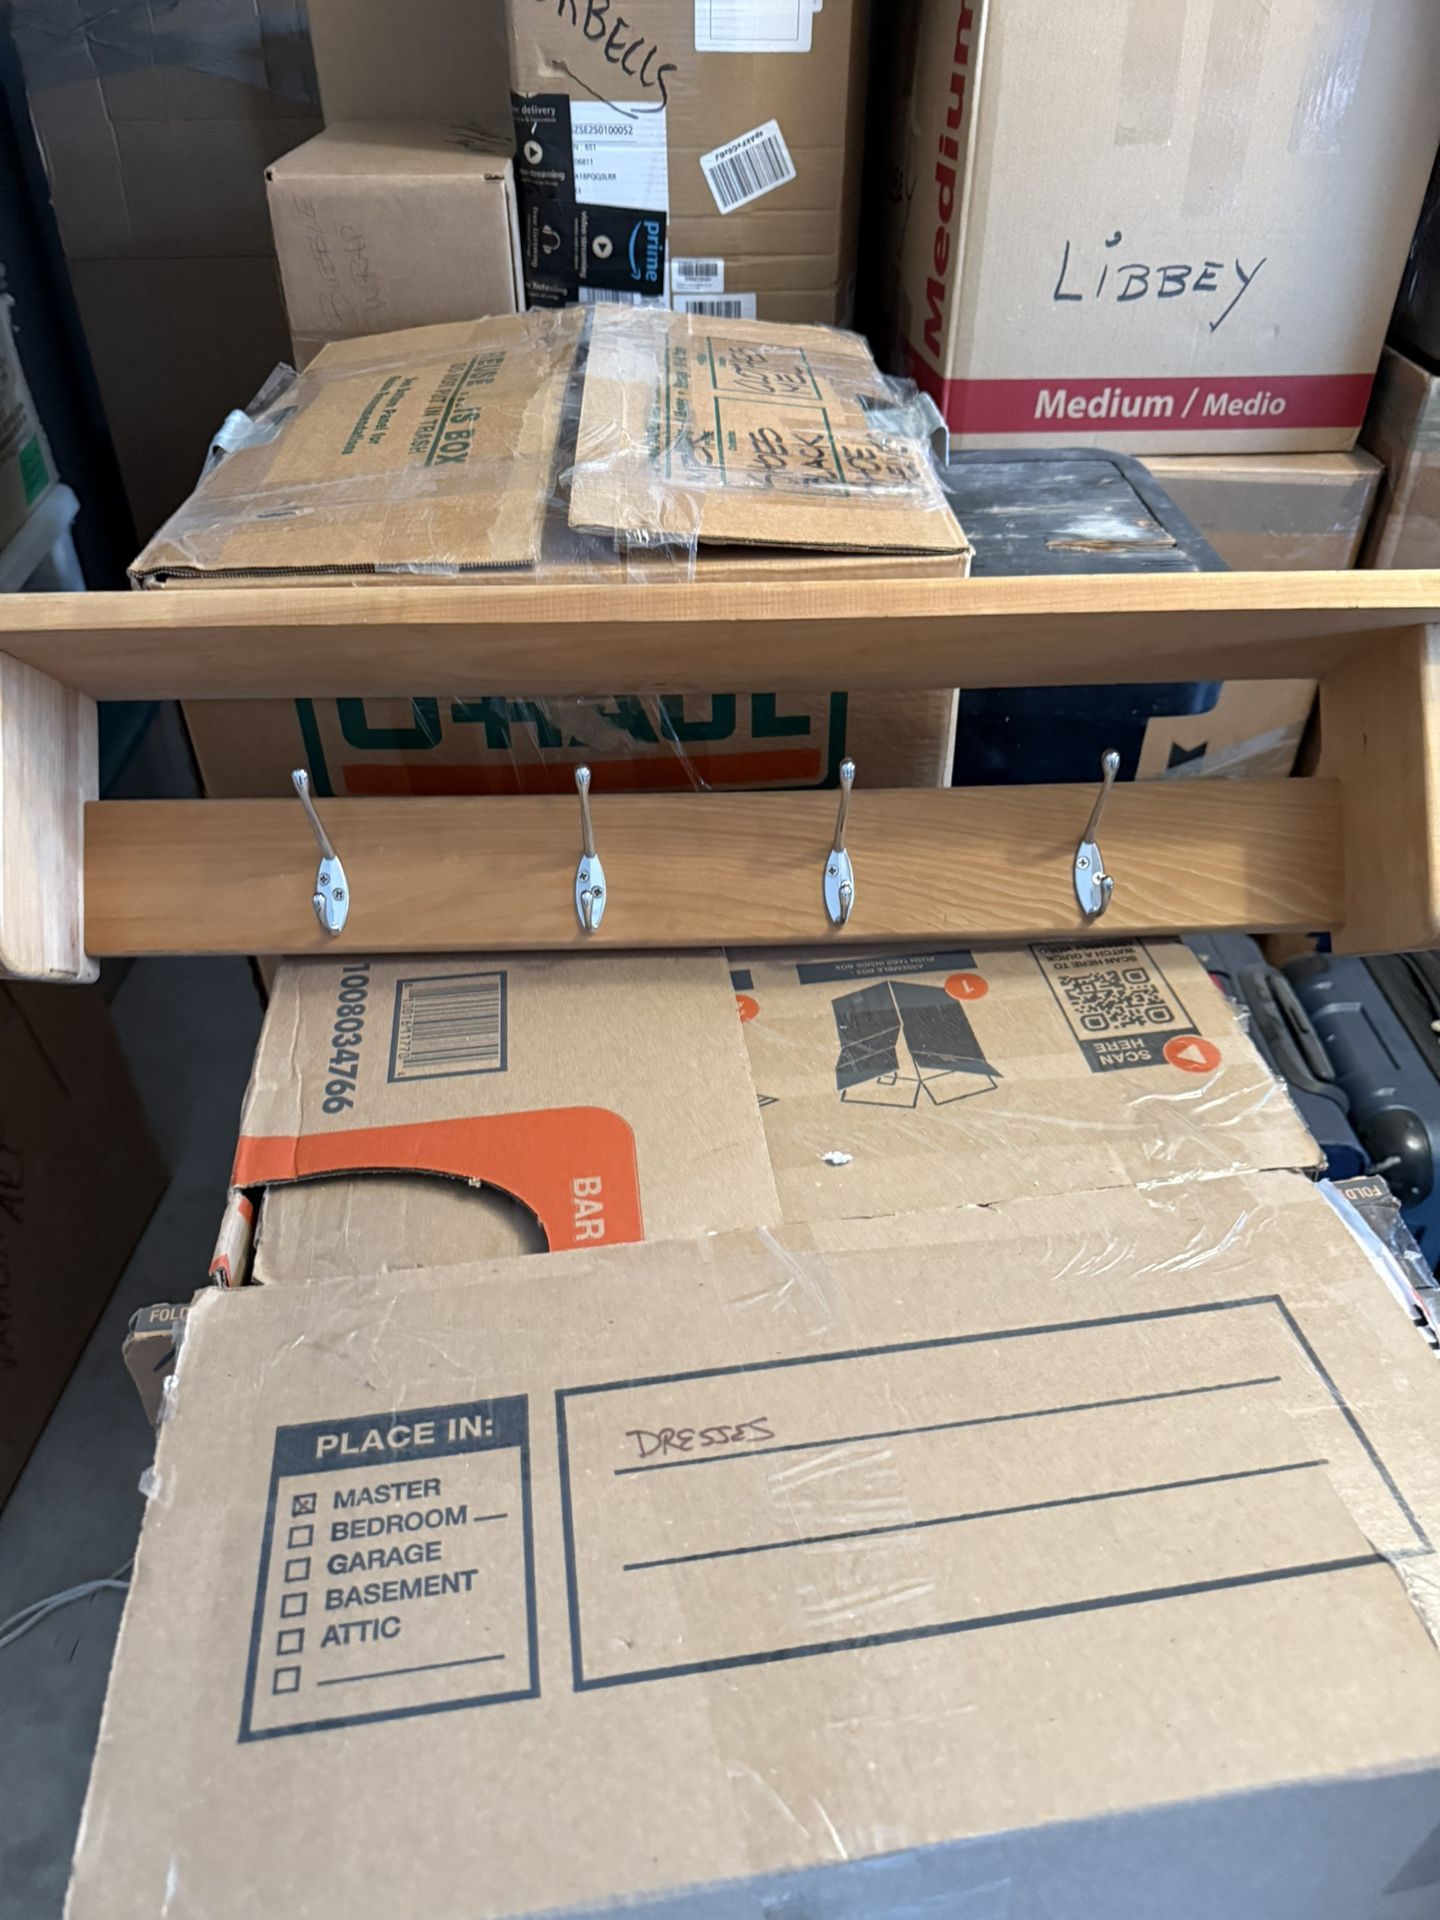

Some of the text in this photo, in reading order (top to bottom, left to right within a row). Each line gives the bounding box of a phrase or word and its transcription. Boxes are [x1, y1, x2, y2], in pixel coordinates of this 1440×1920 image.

[521, 105, 556, 117] delivery
[644, 220, 663, 282] prime
[423, 406, 443, 417] IN
[1034, 387, 1286, 419] Medium / Medio
[408, 418, 438, 455] TRASH
[434, 429, 475, 465] BOX
[1046, 953, 1082, 962] QUICK
[1071, 959, 1103, 968] HERE
[1094, 948, 1136, 957] WATCH
[1105, 955, 1137, 965] SCAN
[962, 980, 974, 993] 1
[322, 962, 370, 1114] 1008034766
[1093, 1038, 1146, 1053] HERE
[1100, 1049, 1152, 1065] SCAN
[1345, 1184, 1382, 1200] FOLD
[572, 1175, 605, 1241] BAR
[149, 1307, 189, 1323] FOLD
[315, 1415, 493, 1459] PLACE IN:
[626, 1416, 775, 1458] DRESSES
[333, 1478, 441, 1509] MASTER
[330, 1505, 467, 1542] BEDROOM
[327, 1540, 442, 1576] GARAGE
[325, 1568, 479, 1611] BASEMENT
[320, 1615, 401, 1648] ATTIC
